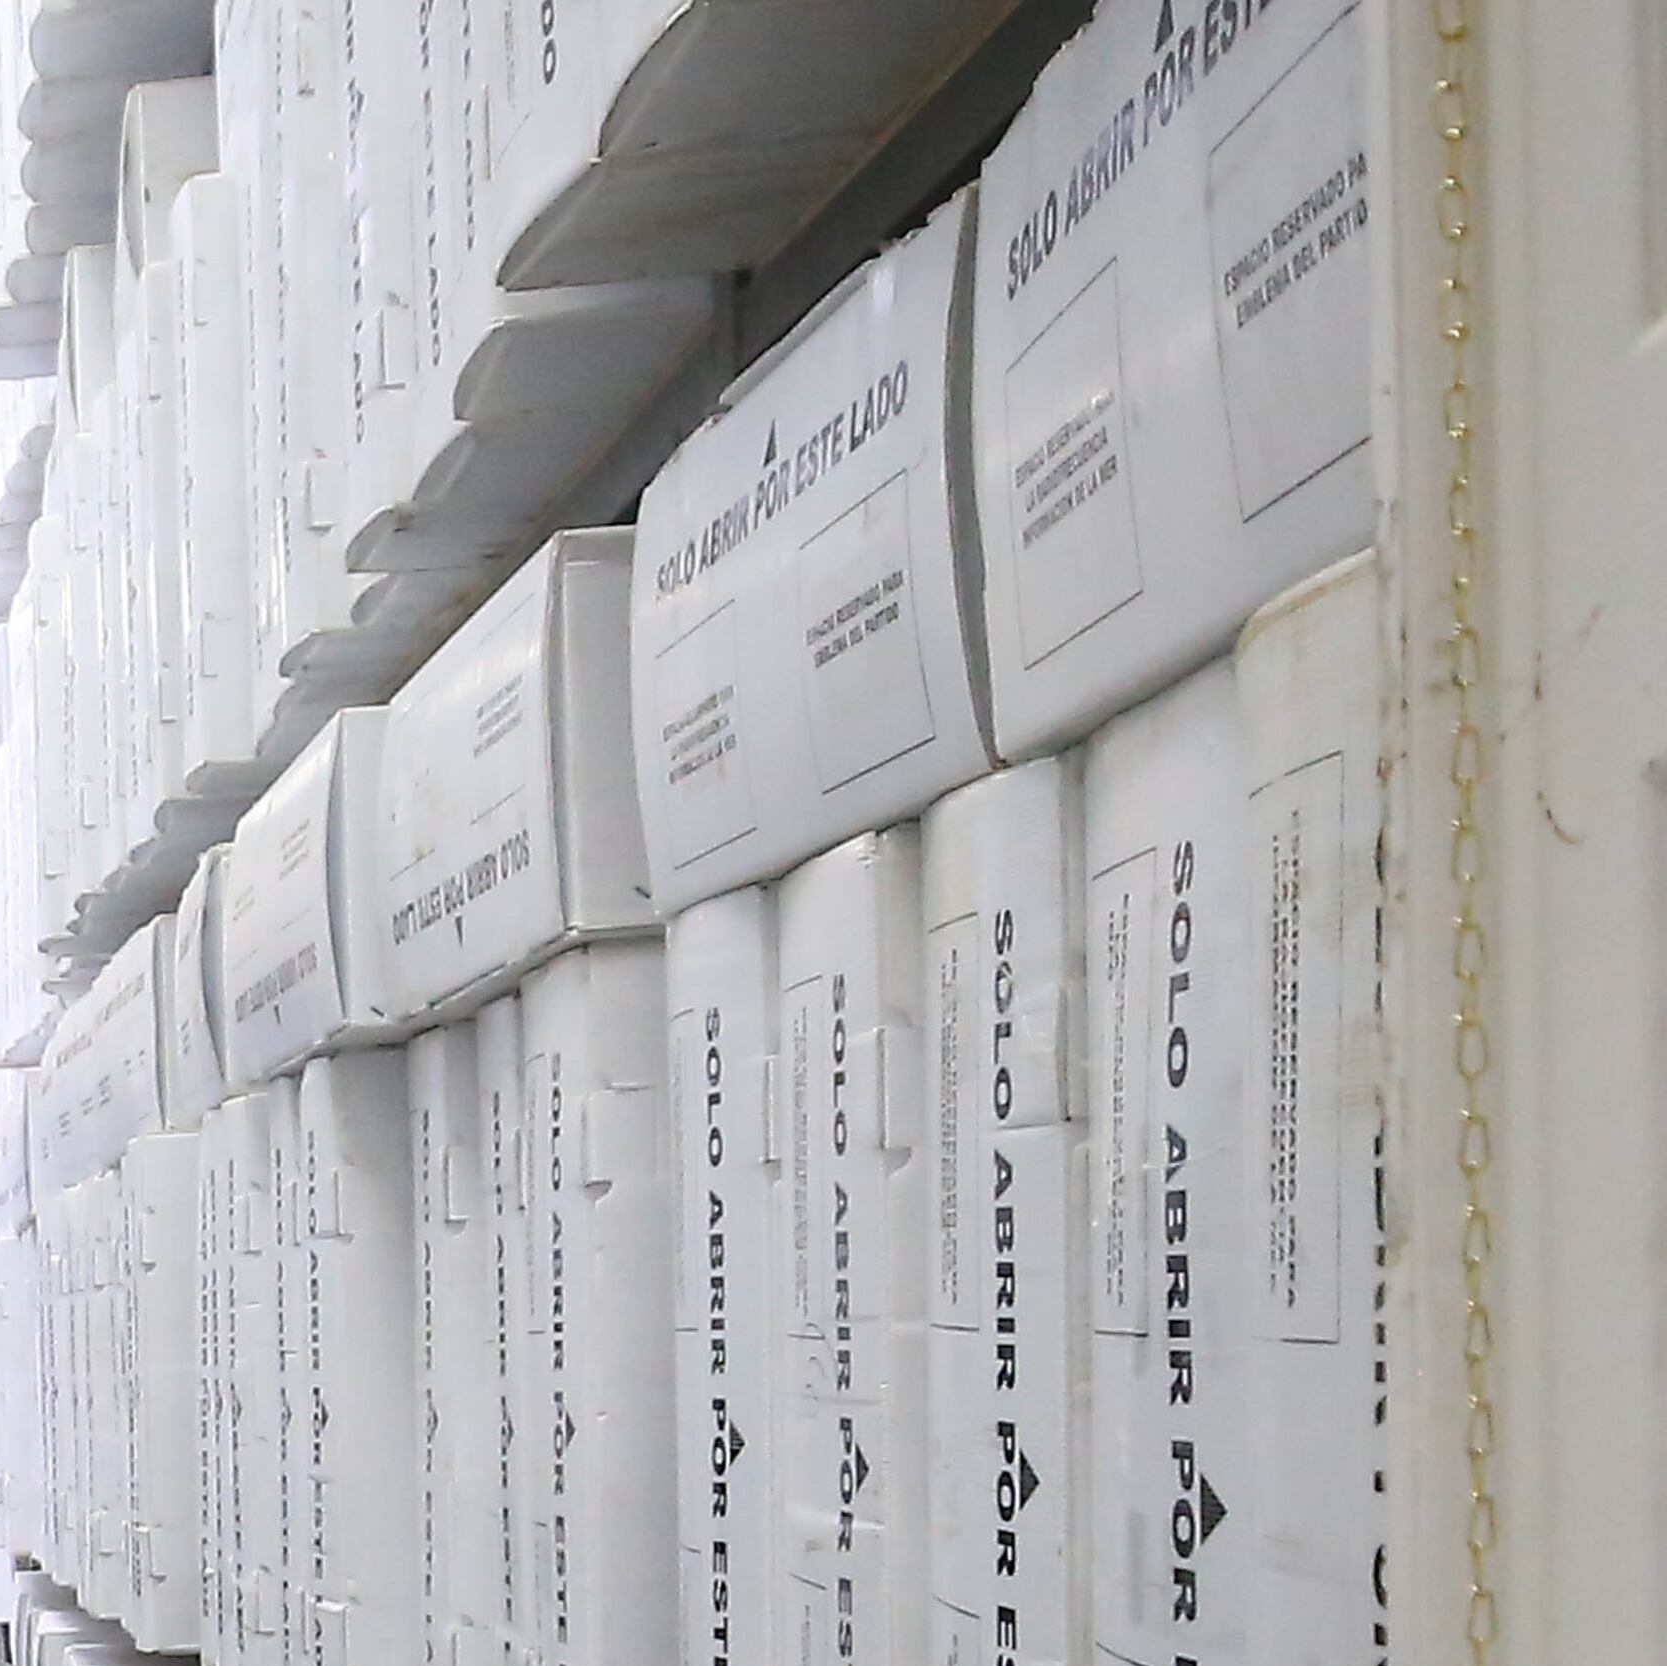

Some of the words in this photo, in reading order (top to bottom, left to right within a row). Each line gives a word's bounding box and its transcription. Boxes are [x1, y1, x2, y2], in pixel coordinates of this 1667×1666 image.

[1006, 189, 1058, 301] SOLO
[1065, 98, 1135, 237] ABRIR
[1143, 26, 1196, 148] POR
[1204, 0, 1267, 77] EST
[656, 539, 696, 593] SOLO
[698, 502, 749, 573] ABRIR
[753, 459, 790, 529] POR
[794, 412, 845, 497] ESTE
[849, 360, 909, 452] LADO
[992, 910, 1013, 1120] SOLO
[1166, 842, 1193, 1088] SOLO
[705, 1007, 723, 1167] SOLO
[832, 974, 847, 1156] SOLO
[708, 1191, 726, 1374] ABRIR
[834, 1184, 851, 1390] ABRIR
[993, 1152, 1015, 1389] ABRIR
[1165, 1128, 1192, 1404] ABRIR
[711, 1398, 727, 1517] POR
[837, 1417, 852, 1551] POR
[995, 1420, 1016, 1577] POR
[1171, 1440, 1196, 1621] POR
